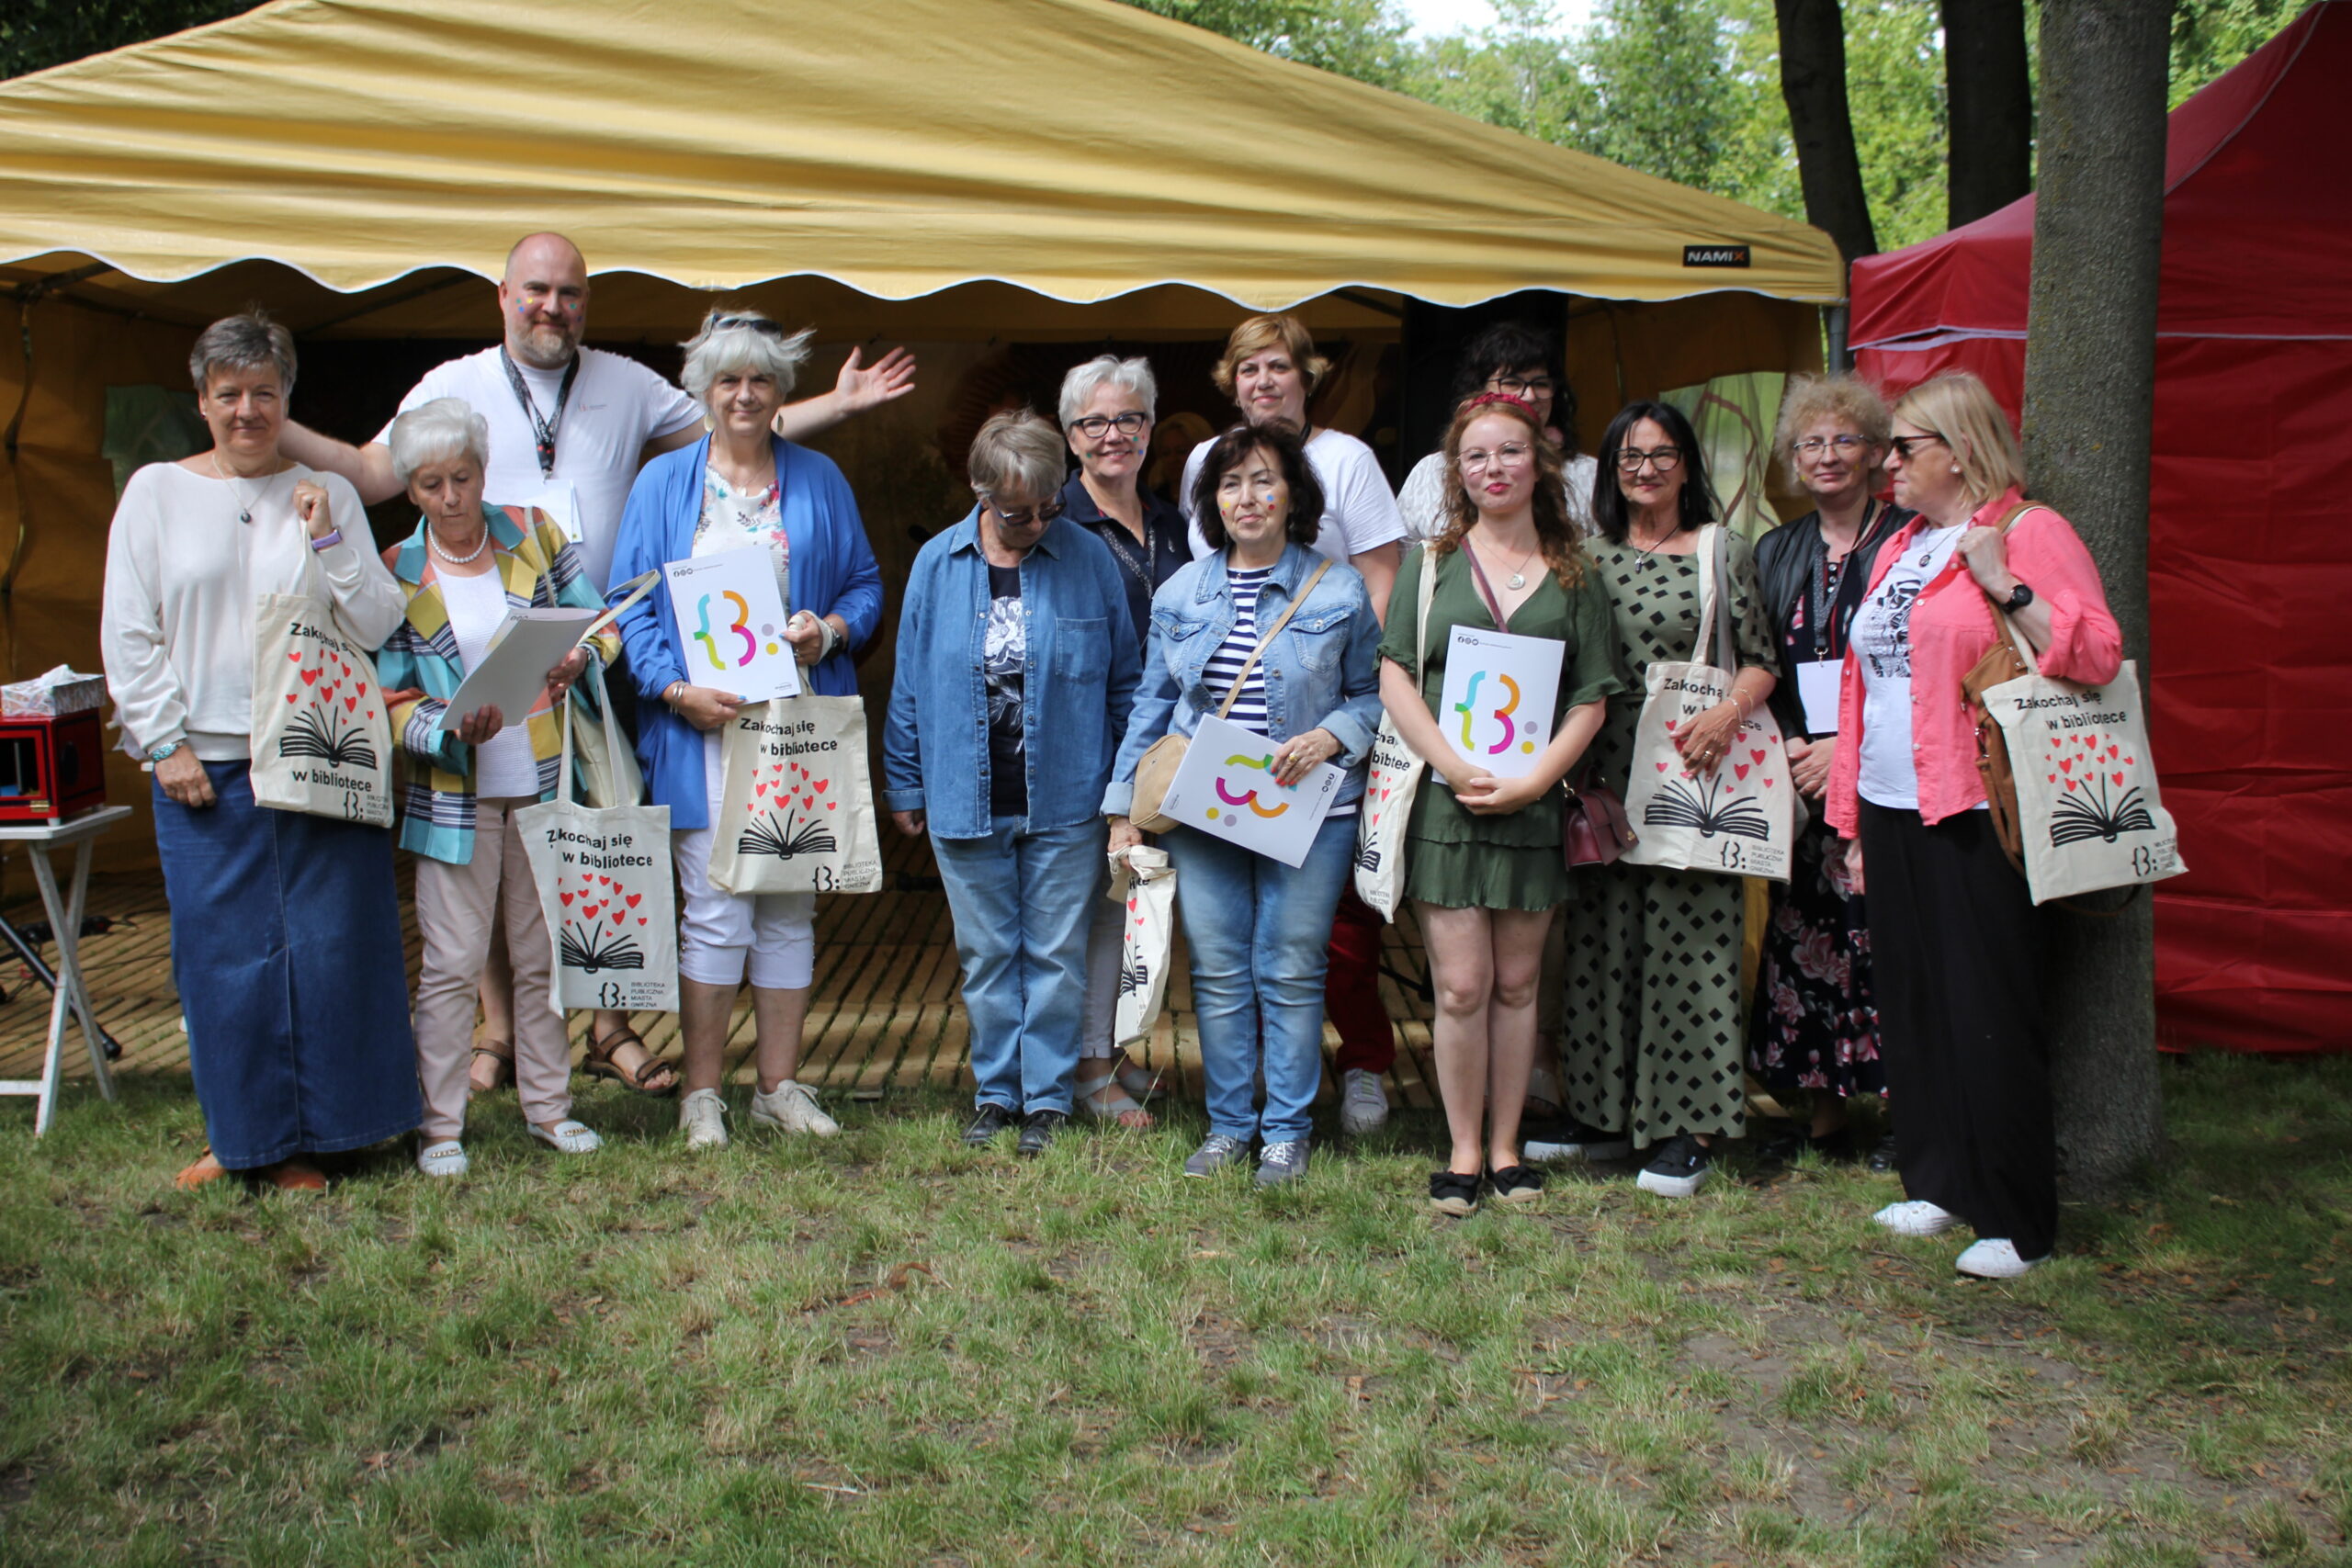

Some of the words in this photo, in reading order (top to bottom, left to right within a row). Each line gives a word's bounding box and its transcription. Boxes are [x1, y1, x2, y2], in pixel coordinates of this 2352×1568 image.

[1687, 250, 1745, 263] NAMIX
[2014, 694, 2079, 710] Zakochaj
[2081, 690, 2102, 705] się
[1682, 705, 1697, 716] w
[740, 717, 795, 737] Zakochaj
[797, 720, 815, 735] się
[2046, 719, 2058, 730] w
[2061, 711, 2127, 728] bibliotece
[760, 743, 770, 754] w
[771, 739, 837, 756] bibliotece
[292, 771, 308, 782] w
[311, 768, 372, 792] bibliotece
[611, 833, 633, 848] się
[562, 852, 574, 863] w
[580, 851, 652, 869] bibliotece
